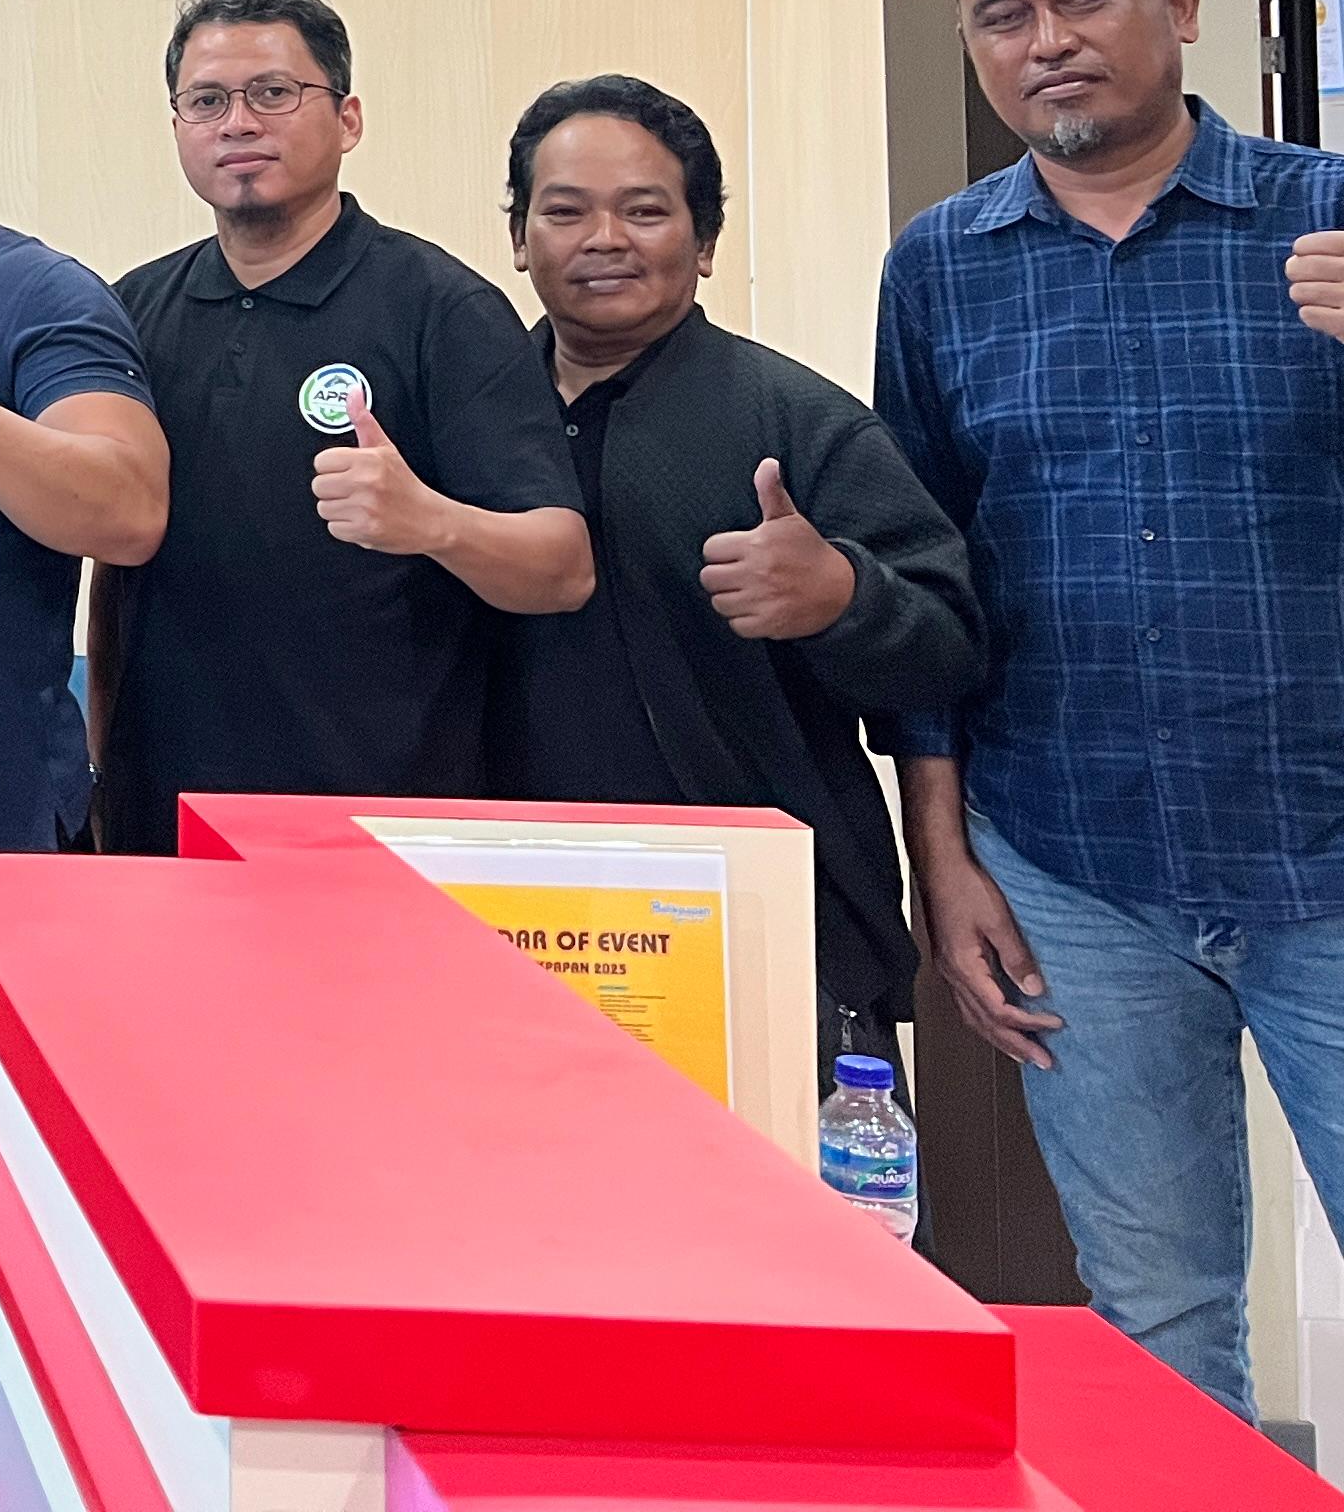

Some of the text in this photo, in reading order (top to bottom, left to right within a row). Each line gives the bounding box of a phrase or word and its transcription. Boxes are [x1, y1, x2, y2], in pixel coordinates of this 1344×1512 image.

[313, 390, 349, 403] APR
[556, 931, 589, 951] OF
[597, 932, 670, 954] EVENT
[594, 963, 627, 975] 2025
